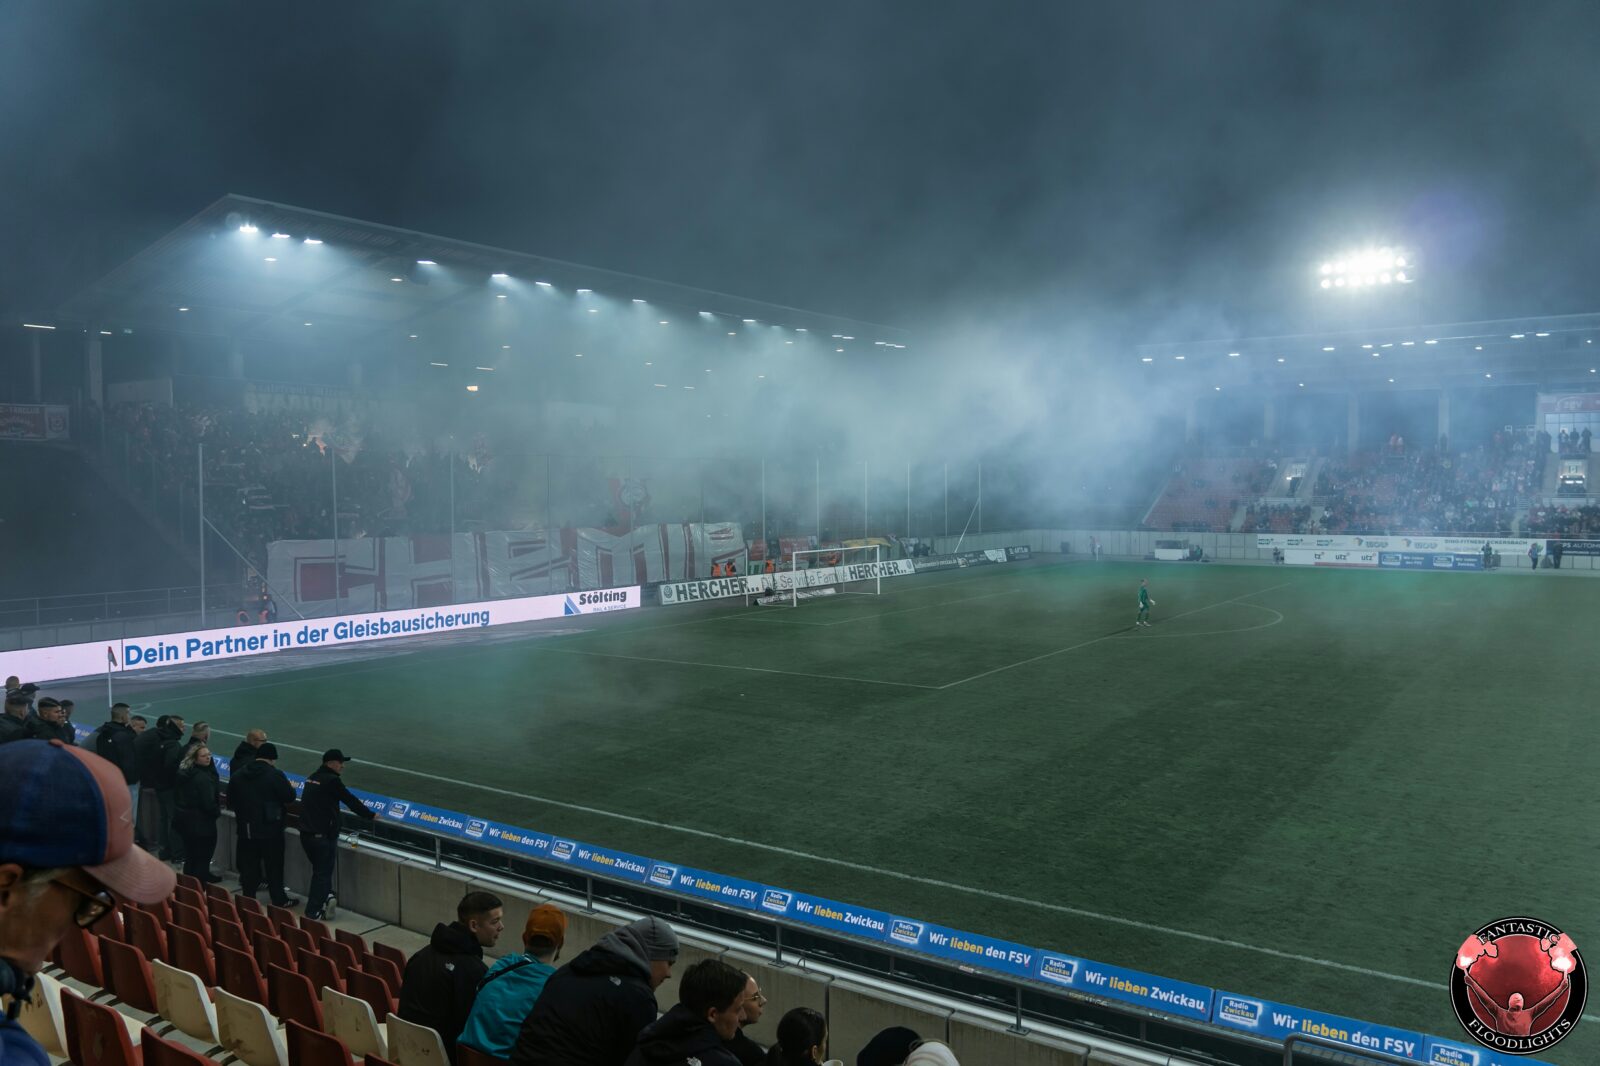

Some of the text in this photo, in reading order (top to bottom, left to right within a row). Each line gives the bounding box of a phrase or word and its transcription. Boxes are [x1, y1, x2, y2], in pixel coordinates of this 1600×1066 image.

[780, 573, 815, 588] Sevice
[579, 590, 627, 605] Stölting
[124, 609, 490, 666] Dein Partner in der Gleisbausicherung
[374, 801, 386, 810] FSV
[409, 809, 420, 818] Wir
[420, 811, 439, 823] lieben
[438, 816, 463, 829] Zwickau
[489, 827, 501, 837] Wir
[501, 830, 521, 842] lieben
[521, 837, 534, 846] den
[534, 839, 549, 849] FSV
[578, 849, 592, 860] Wir
[591, 852, 614, 866] lieben
[614, 858, 646, 873] Zwickau
[680, 874, 695, 886] Wir
[695, 878, 721, 893] lieben
[721, 885, 738, 897] den
[739, 889, 758, 901] FSV
[770, 892, 783, 900] Radio
[796, 900, 813, 913] Wir
[813, 905, 843, 921] lieben
[844, 912, 884, 930] Zwickau
[893, 927, 917, 937] Zwickau
[898, 922, 914, 931] Radio
[929, 931, 948, 946] Wir
[949, 936, 983, 954] lieben
[985, 945, 1006, 960] den
[1008, 951, 1031, 966] FSV
[1044, 964, 1071, 976] Zwickau
[1049, 959, 1066, 969] Radio
[1085, 970, 1107, 986] Wir
[1109, 976, 1148, 996] lieben
[1150, 986, 1205, 1010] Zwickau
[1224, 1005, 1255, 1018] Zwickau
[1229, 1000, 1249, 1010] Radio
[1272, 1012, 1299, 1029] Wir
[1302, 1019, 1348, 1041] lieben
[1351, 1031, 1380, 1048] den
[1384, 1037, 1415, 1055] FSV
[1440, 1047, 1463, 1060] Radio
